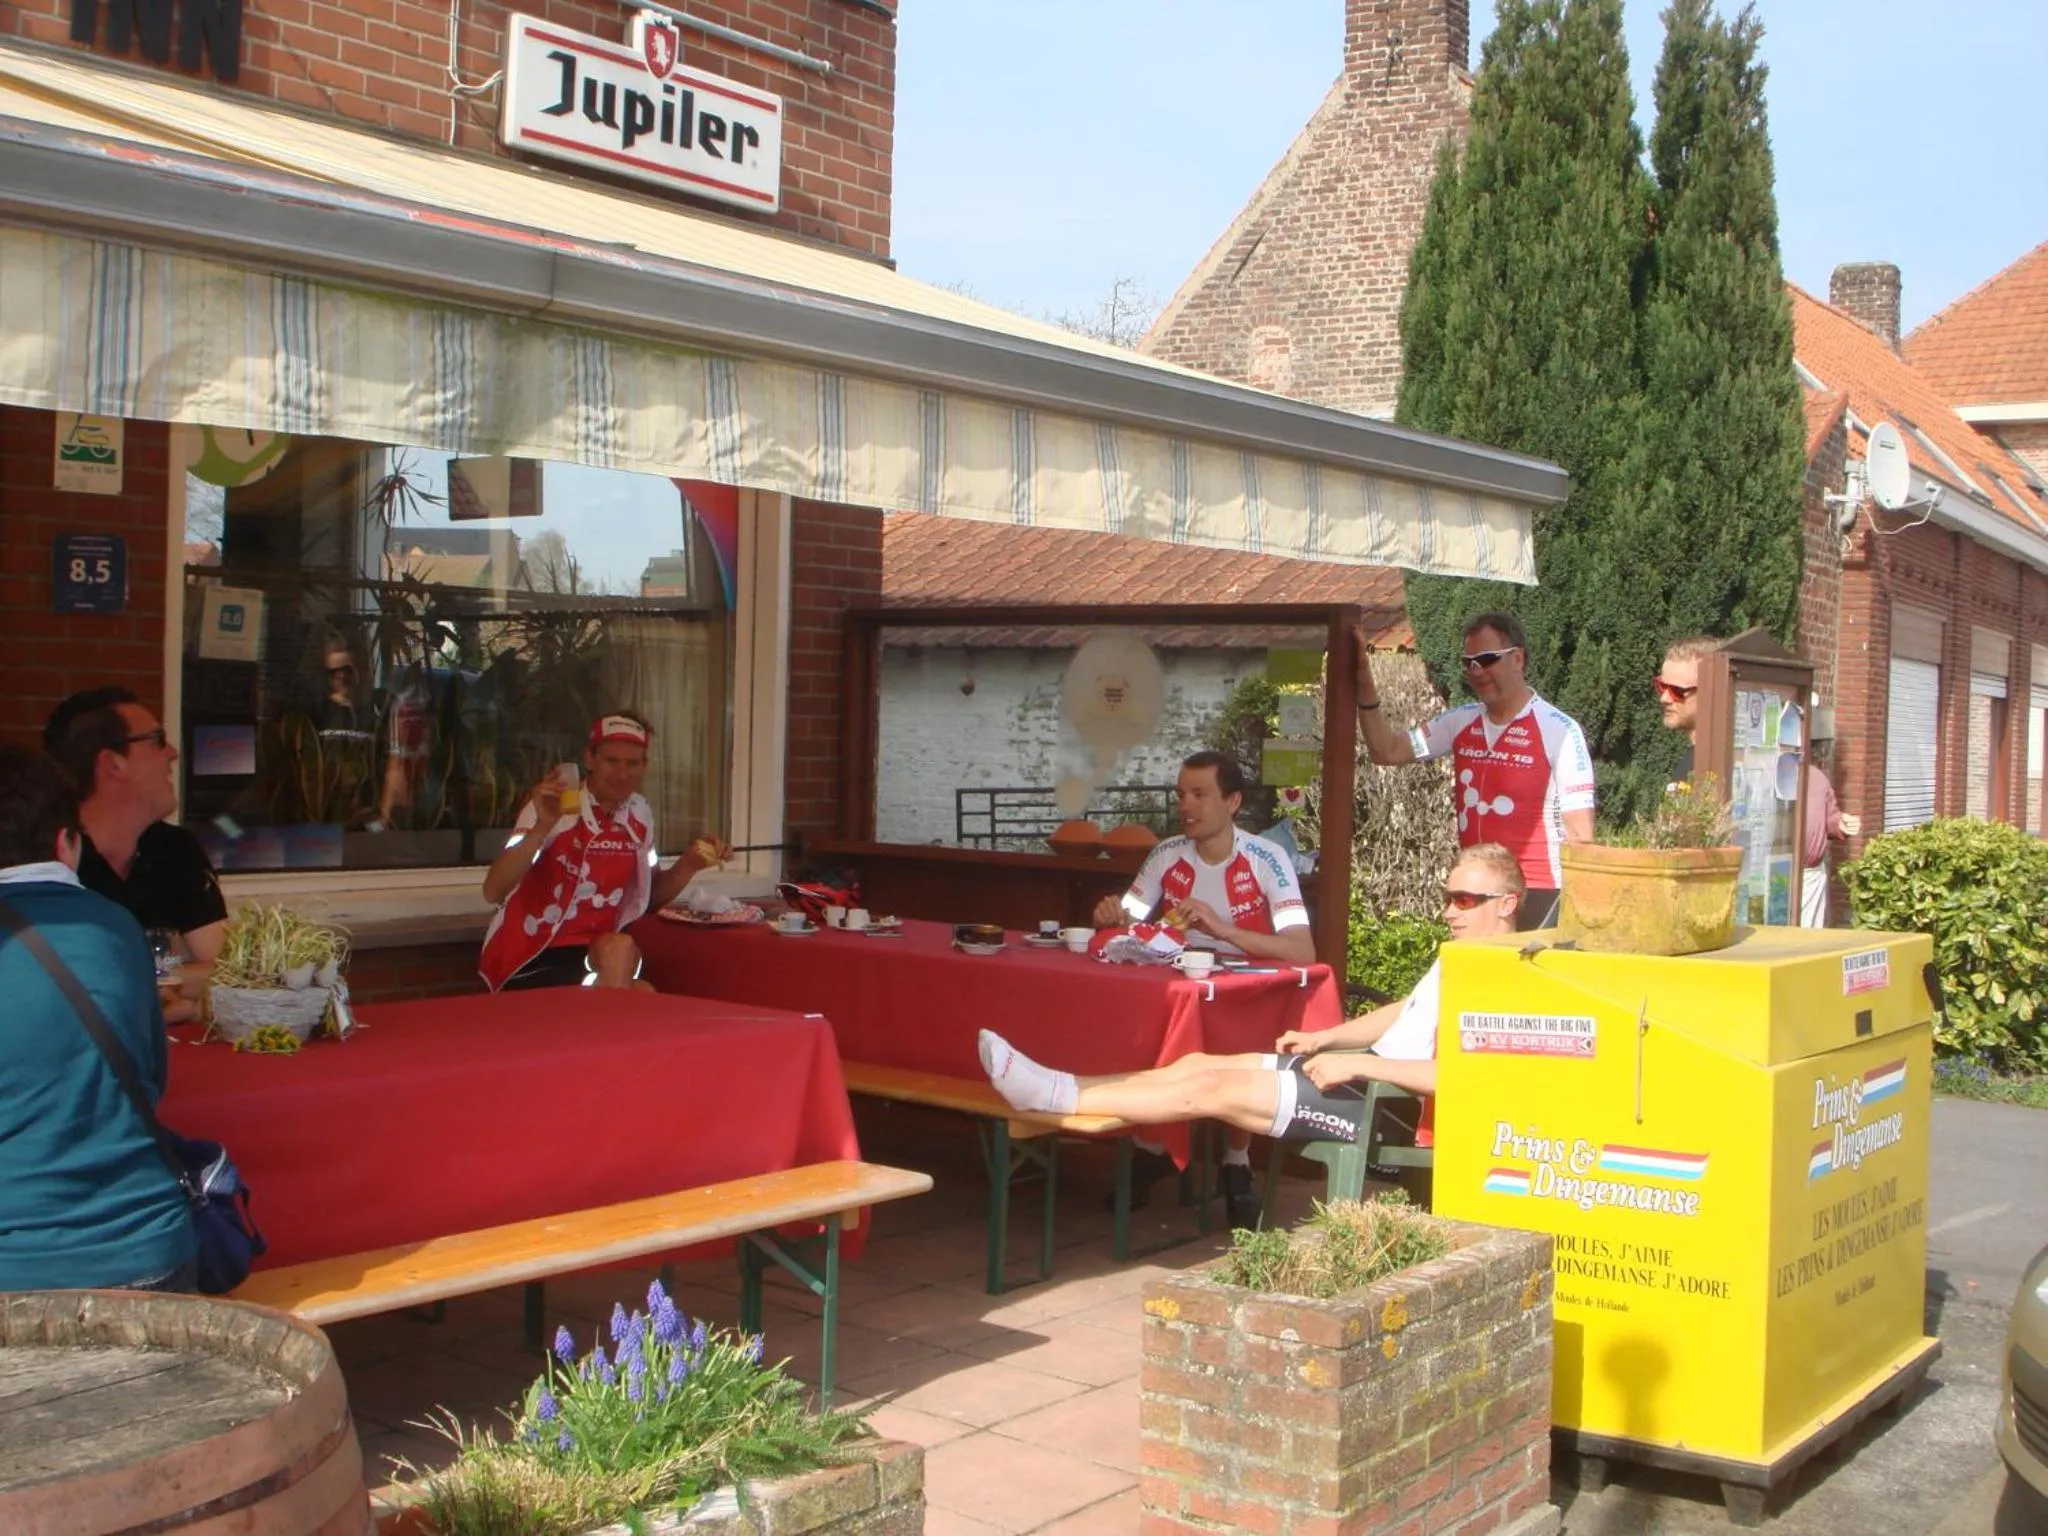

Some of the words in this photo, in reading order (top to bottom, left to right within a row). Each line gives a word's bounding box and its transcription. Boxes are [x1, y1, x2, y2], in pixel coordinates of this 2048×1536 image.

[538, 50, 759, 164] Jupiler
[70, 558, 110, 585] 8,5
[1246, 842, 1290, 888] postnord
[1478, 1016, 1506, 1030] BATTLE
[1508, 1017, 1541, 1031] AGAINST
[1544, 1018, 1559, 1032] THE
[1560, 1019, 1574, 1033] BIG
[1575, 1019, 1592, 1034] FIVE
[1292, 1108, 1356, 1133] RGON
[1812, 1072, 1849, 1130] Prins
[1848, 1077, 1864, 1126] &
[1491, 1120, 1565, 1163] Prins
[1568, 1138, 1598, 1175] &
[1831, 1111, 1904, 1171] Dingemanse
[1532, 1162, 1700, 1216] Dingemanse
[1813, 1208, 1831, 1241] LES
[1556, 1256, 1658, 1288] DINGEMANSE
[1662, 1273, 1732, 1300] J'ADORE
[1618, 1242, 1673, 1268] J'AIME
[1776, 1262, 1796, 1299] LES
[1797, 1248, 1825, 1288] PRINS
[1836, 1213, 1890, 1267] DINGEMANSE
